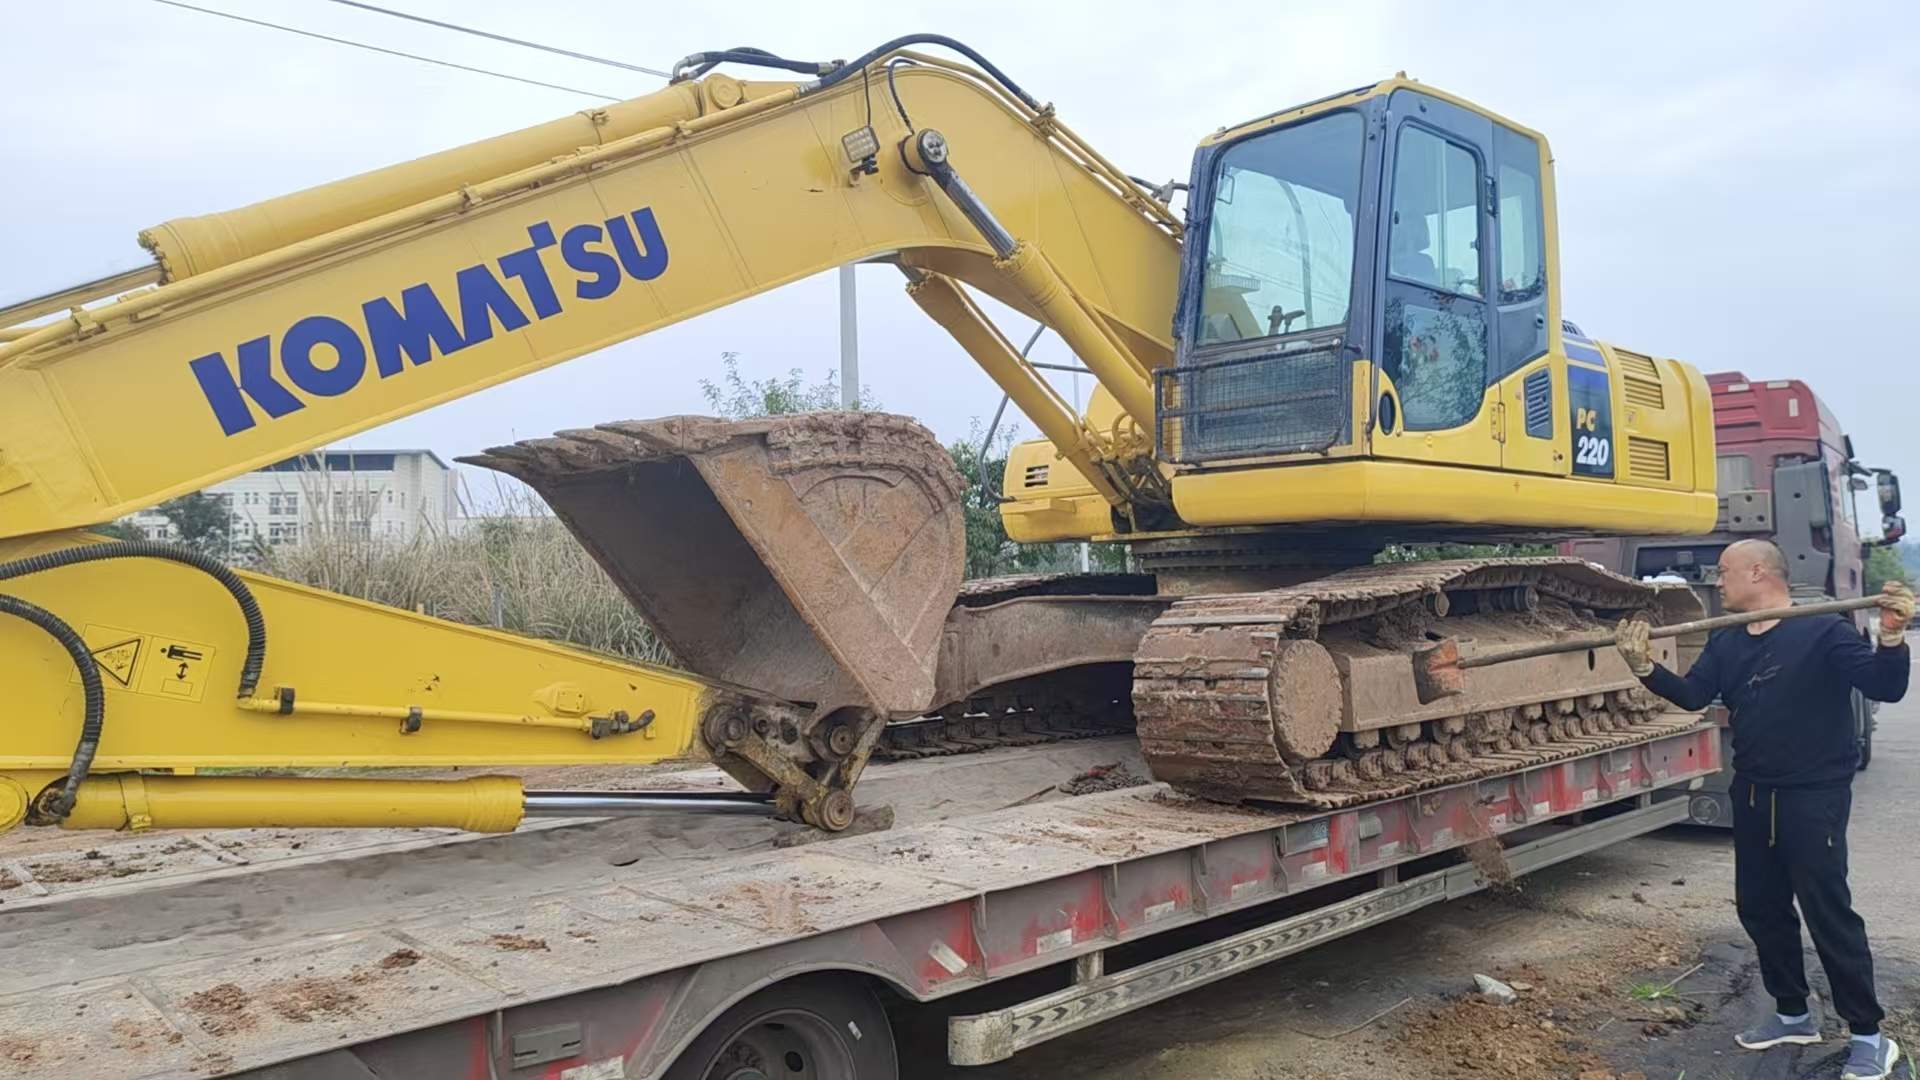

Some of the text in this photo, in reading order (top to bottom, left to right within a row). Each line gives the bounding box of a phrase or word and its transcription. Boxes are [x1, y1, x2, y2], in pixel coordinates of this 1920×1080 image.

[189, 207, 669, 437] KOMATSU
[1576, 407, 1597, 432] PC
[1575, 435, 1610, 467] 220
